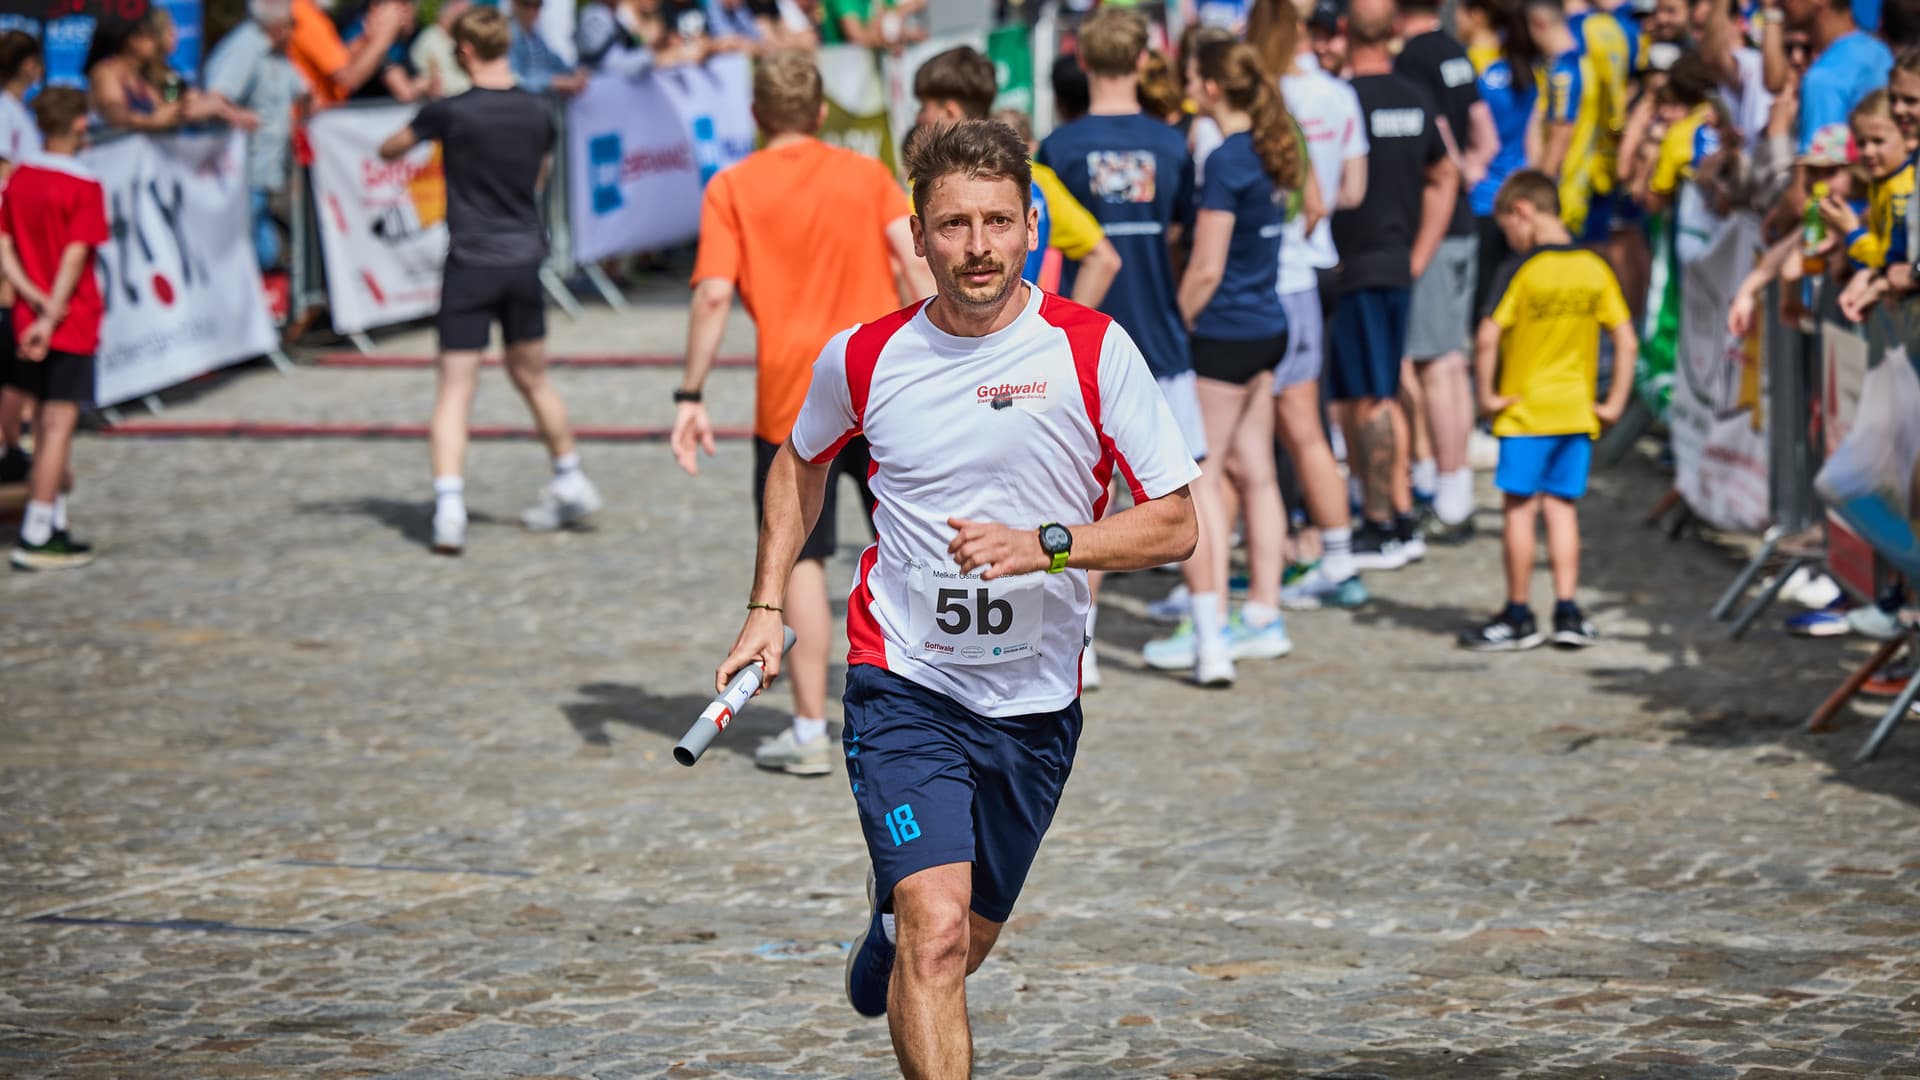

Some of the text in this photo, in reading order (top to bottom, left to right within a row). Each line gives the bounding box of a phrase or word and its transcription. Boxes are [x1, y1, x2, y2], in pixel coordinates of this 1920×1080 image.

[977, 381, 1047, 398] Gottwald
[933, 570, 957, 580] Melker
[935, 587, 1013, 635] 5b
[924, 641, 954, 653] Gottwald
[884, 803, 922, 847] 18
